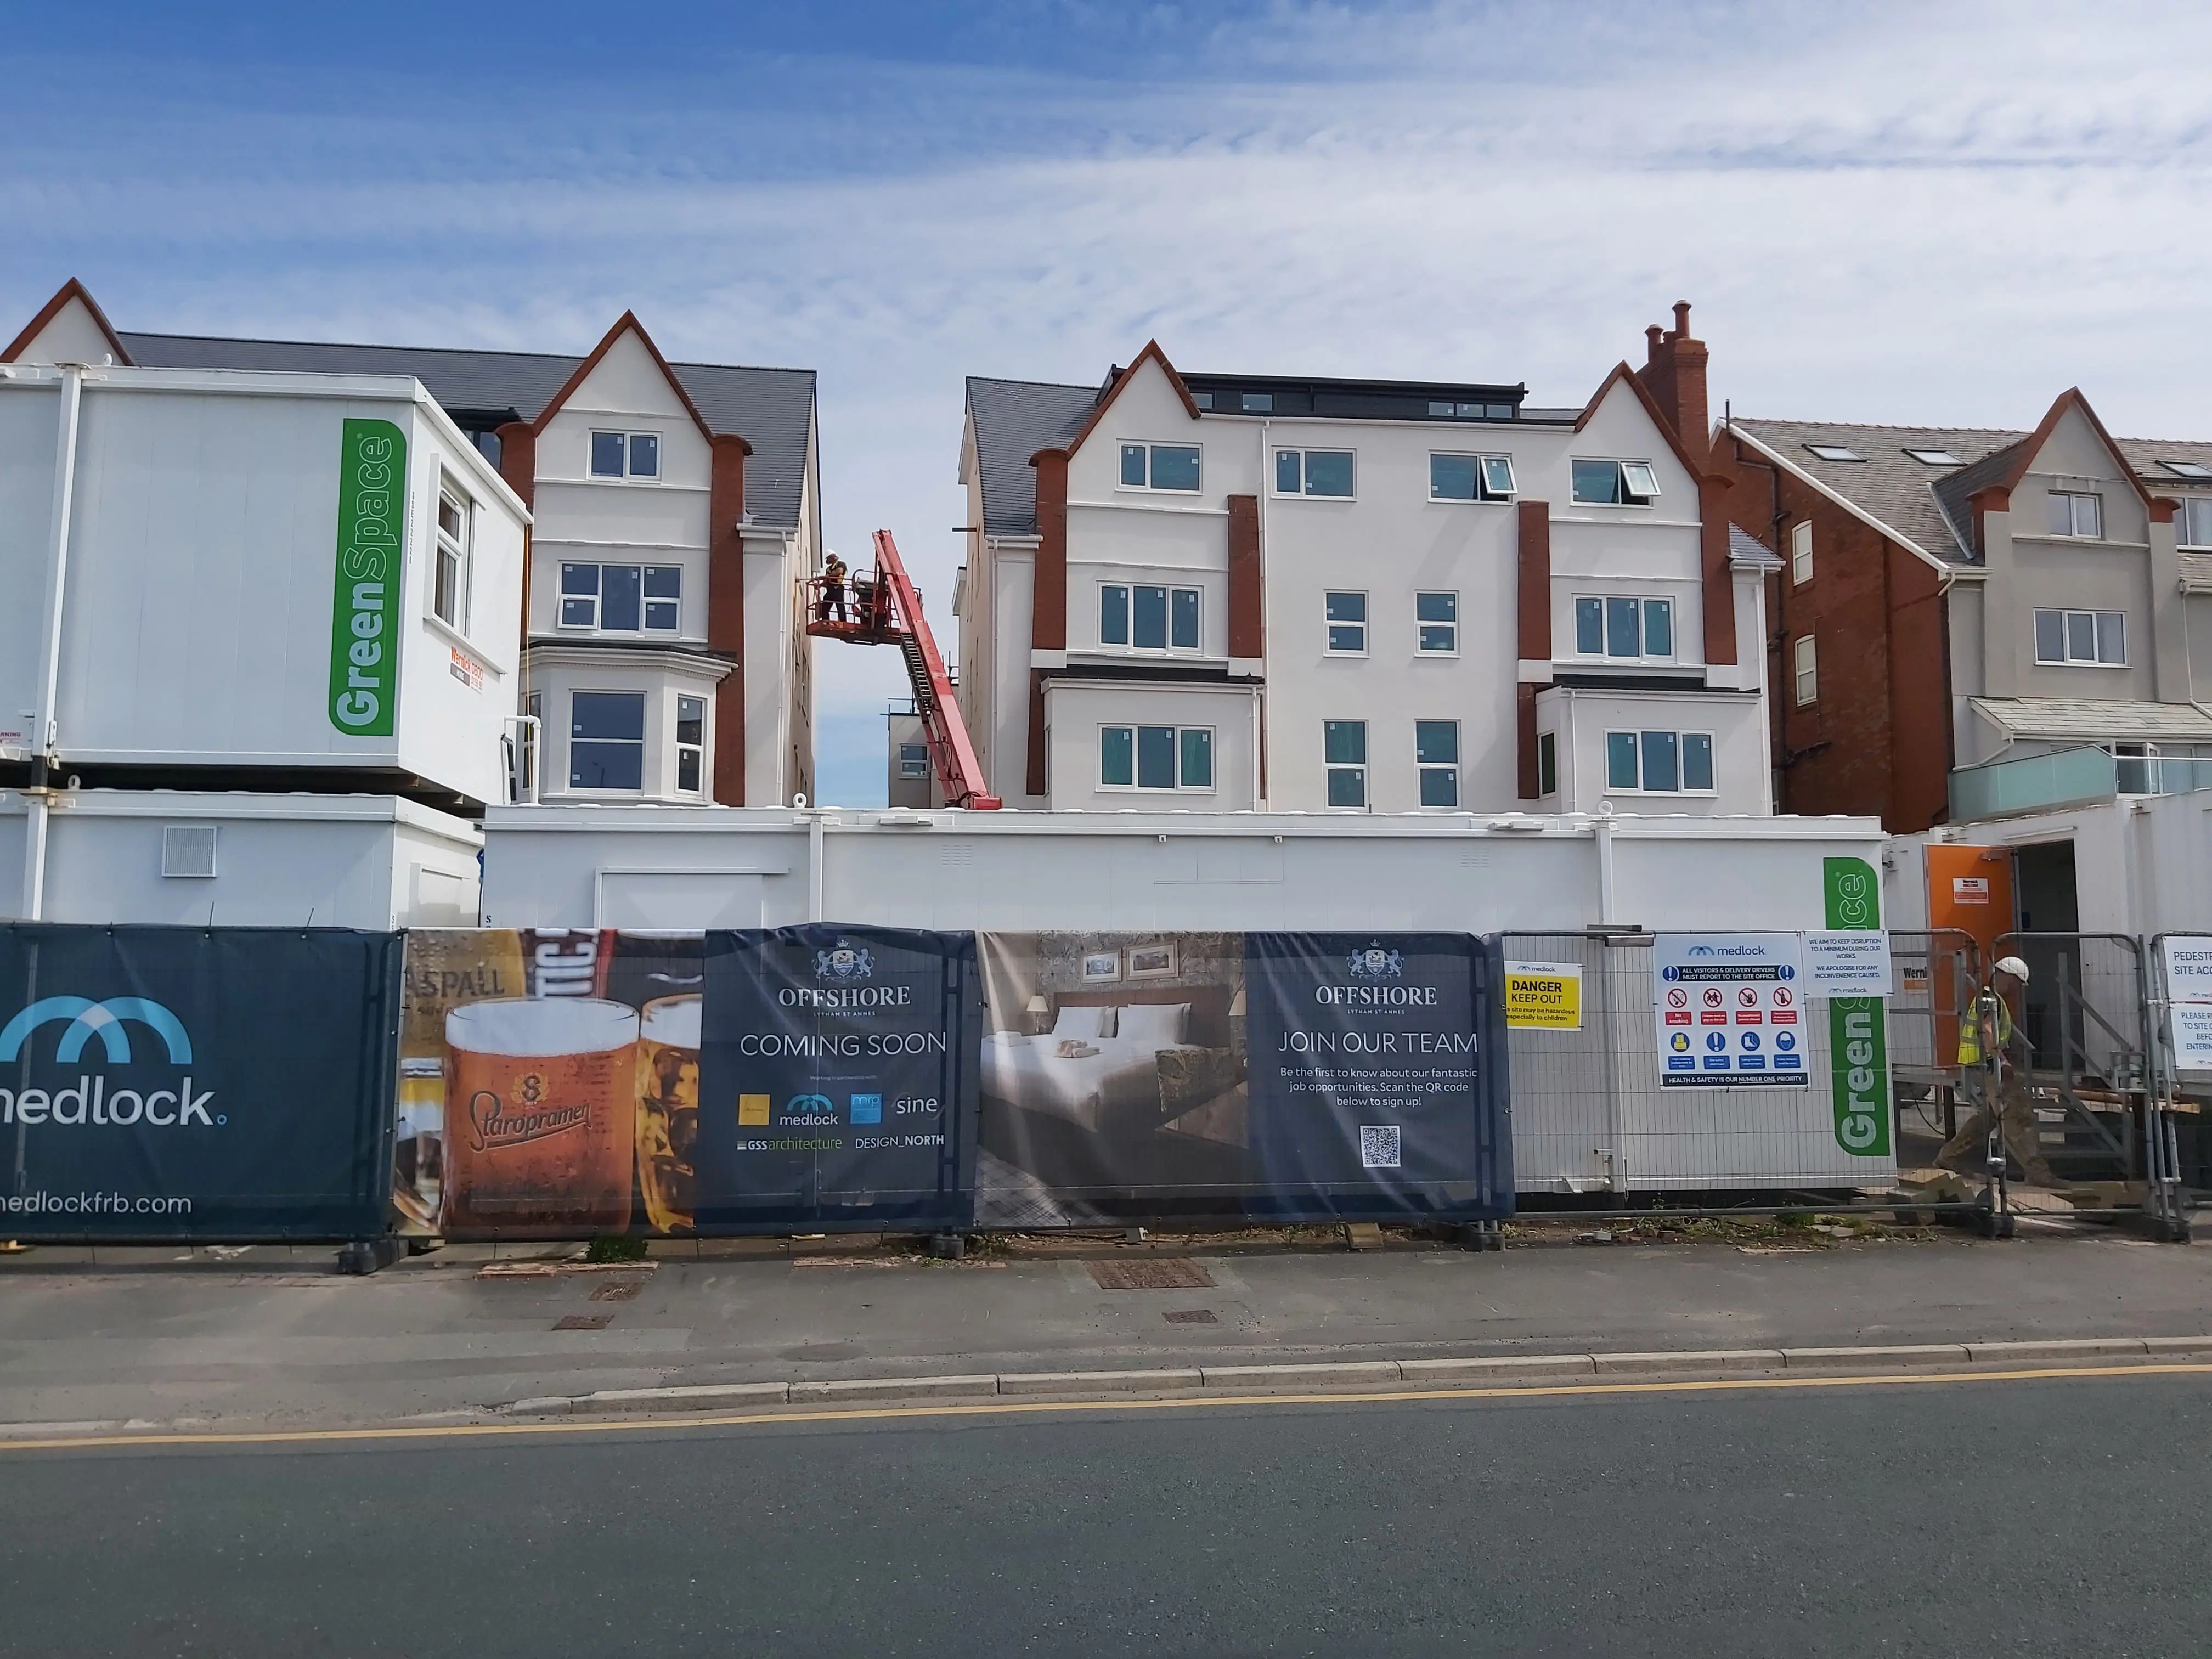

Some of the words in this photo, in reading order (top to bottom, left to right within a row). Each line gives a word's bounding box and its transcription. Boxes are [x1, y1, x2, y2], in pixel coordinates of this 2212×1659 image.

[336, 436, 398, 727] GreenSpace
[1717, 945, 1765, 956] medlock
[1903, 966, 1927, 978] Werni
[2174, 966, 2194, 975] SITE
[1512, 980, 1562, 992] DANGER
[778, 986, 911, 1007] OFFSHORE
[1316, 986, 1437, 1005] OFFSHORE
[1511, 993, 1538, 1003] KEEP
[1541, 994, 1562, 1004] OUT
[741, 1034, 860, 1056] COMING
[867, 1031, 946, 1055] SOON
[1278, 1031, 1335, 1053] JOIN
[1343, 1032, 1398, 1053] OUR
[1401, 1032, 1478, 1053] TEAM
[1280, 1067, 1293, 1076] Be
[1296, 1067, 1313, 1076] the
[1315, 1067, 1335, 1077] first
[1338, 1069, 1348, 1077] to
[1351, 1068, 1378, 1077] know
[1380, 1068, 1409, 1077] about
[1431, 1068, 1477, 1077] fantastic
[1289, 1081, 1306, 1093] job
[1308, 1082, 1378, 1093] opportunities.
[1380, 1082, 1404, 1092] Scan
[1406, 1082, 1423, 1092] the
[1426, 1082, 1442, 1093] QR
[1444, 1082, 1469, 1091] code
[853, 1096, 879, 1107] mrp
[896, 1097, 938, 1114] sine
[1336, 1096, 1368, 1106] below
[1370, 1097, 1380, 1106] to
[1383, 1096, 1403, 1108] sign
[1406, 1097, 1421, 1108] up!
[470, 1091, 592, 1153] Staropramen
[780, 1113, 839, 1125] medlock
[0, 1191, 191, 1214] edlockfrb.com
